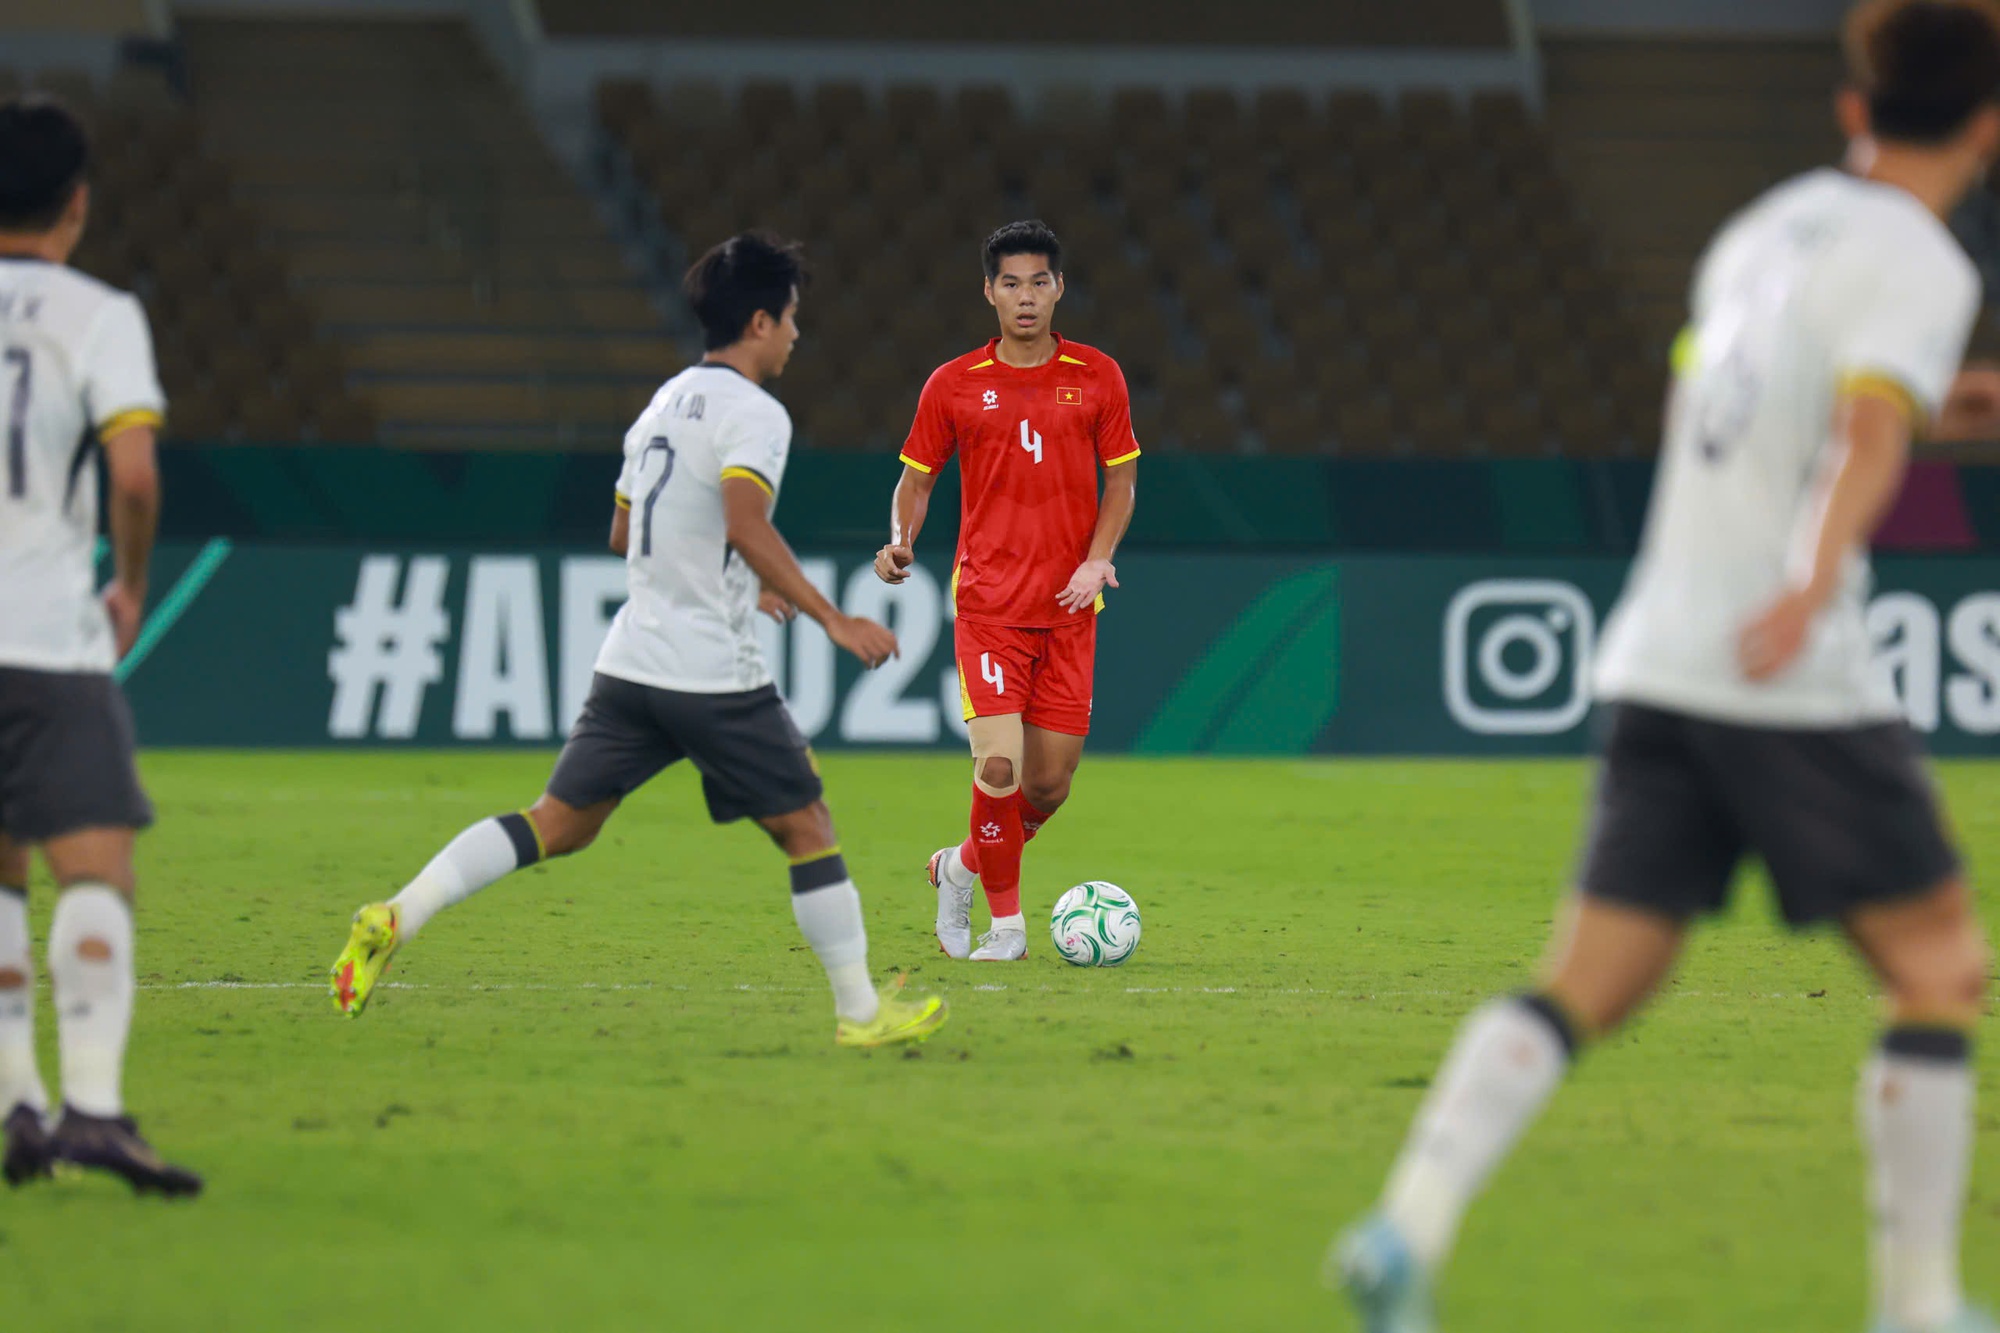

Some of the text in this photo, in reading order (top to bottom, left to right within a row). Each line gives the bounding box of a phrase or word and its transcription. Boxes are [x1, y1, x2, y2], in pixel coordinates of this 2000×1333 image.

[1019, 418, 1043, 464] 4
[639, 435, 676, 557] 7
[981, 652, 1005, 695] 4
